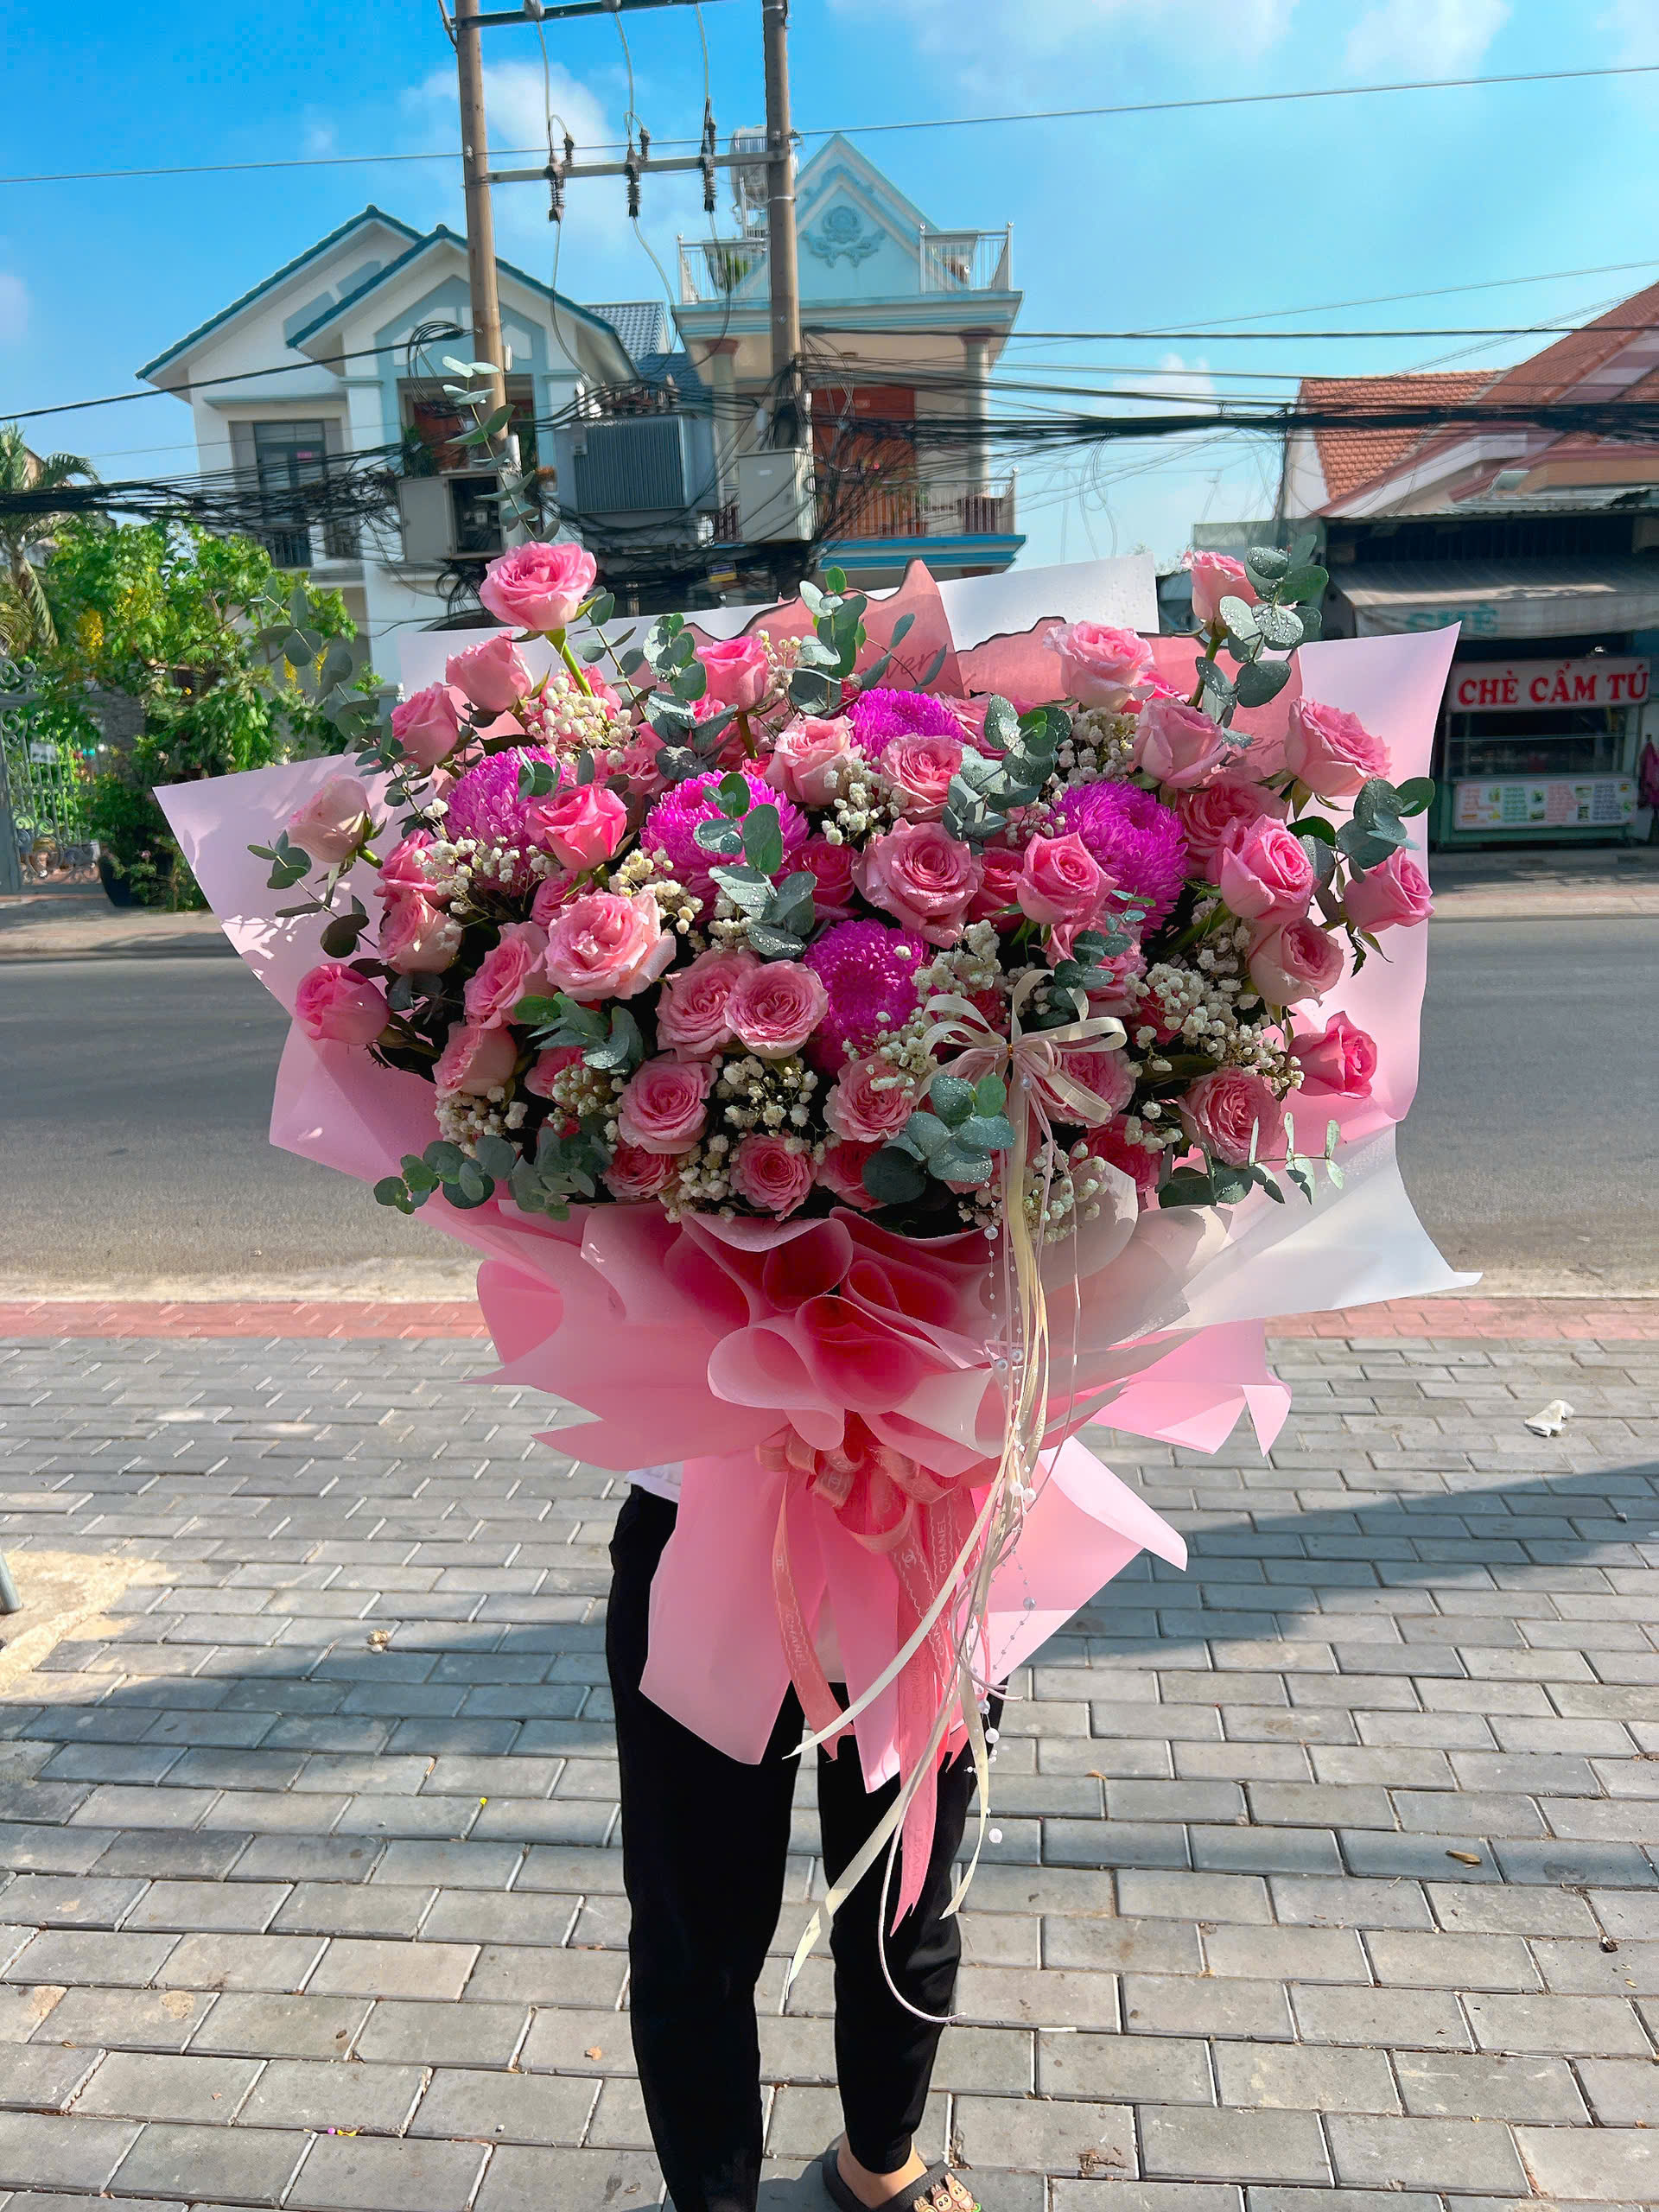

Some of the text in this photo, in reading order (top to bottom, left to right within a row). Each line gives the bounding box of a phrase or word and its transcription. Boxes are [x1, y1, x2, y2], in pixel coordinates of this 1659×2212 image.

[1458, 671, 1519, 706] CHÈ
[1607, 664, 1649, 701] TÚ
[937, 1514, 948, 1574] CHANEL
